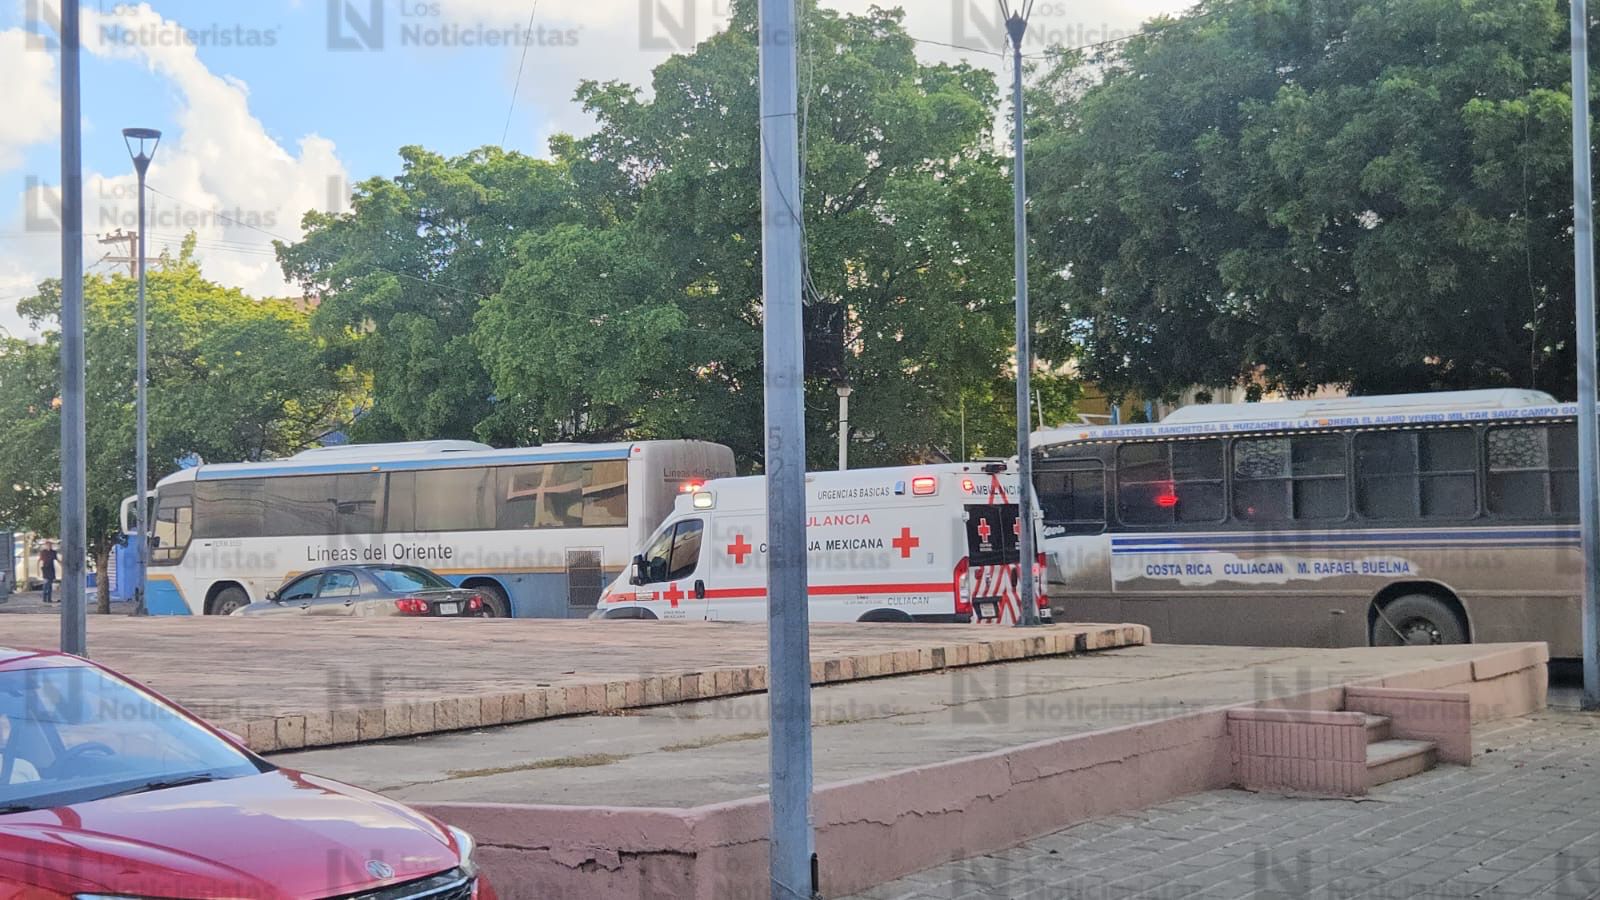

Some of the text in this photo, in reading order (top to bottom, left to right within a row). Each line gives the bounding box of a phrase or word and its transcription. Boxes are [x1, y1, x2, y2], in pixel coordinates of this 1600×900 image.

[1408, 413, 1444, 421] VIVERO
[1521, 407, 1557, 416] CAMPO
[1562, 406, 1577, 414] GO
[817, 486, 889, 500] URGENCIAS BASICAS
[971, 484, 1021, 496] AMBULANCI
[805, 513, 871, 527] ULANCIA
[363, 543, 387, 560] del
[392, 542, 453, 560] Oriente
[826, 537, 884, 551] MEXICANA
[1146, 561, 1410, 576] COSTA RICA CULIACAN M. RAFAEL BUELNA
[887, 597, 929, 606] CULIACAN
